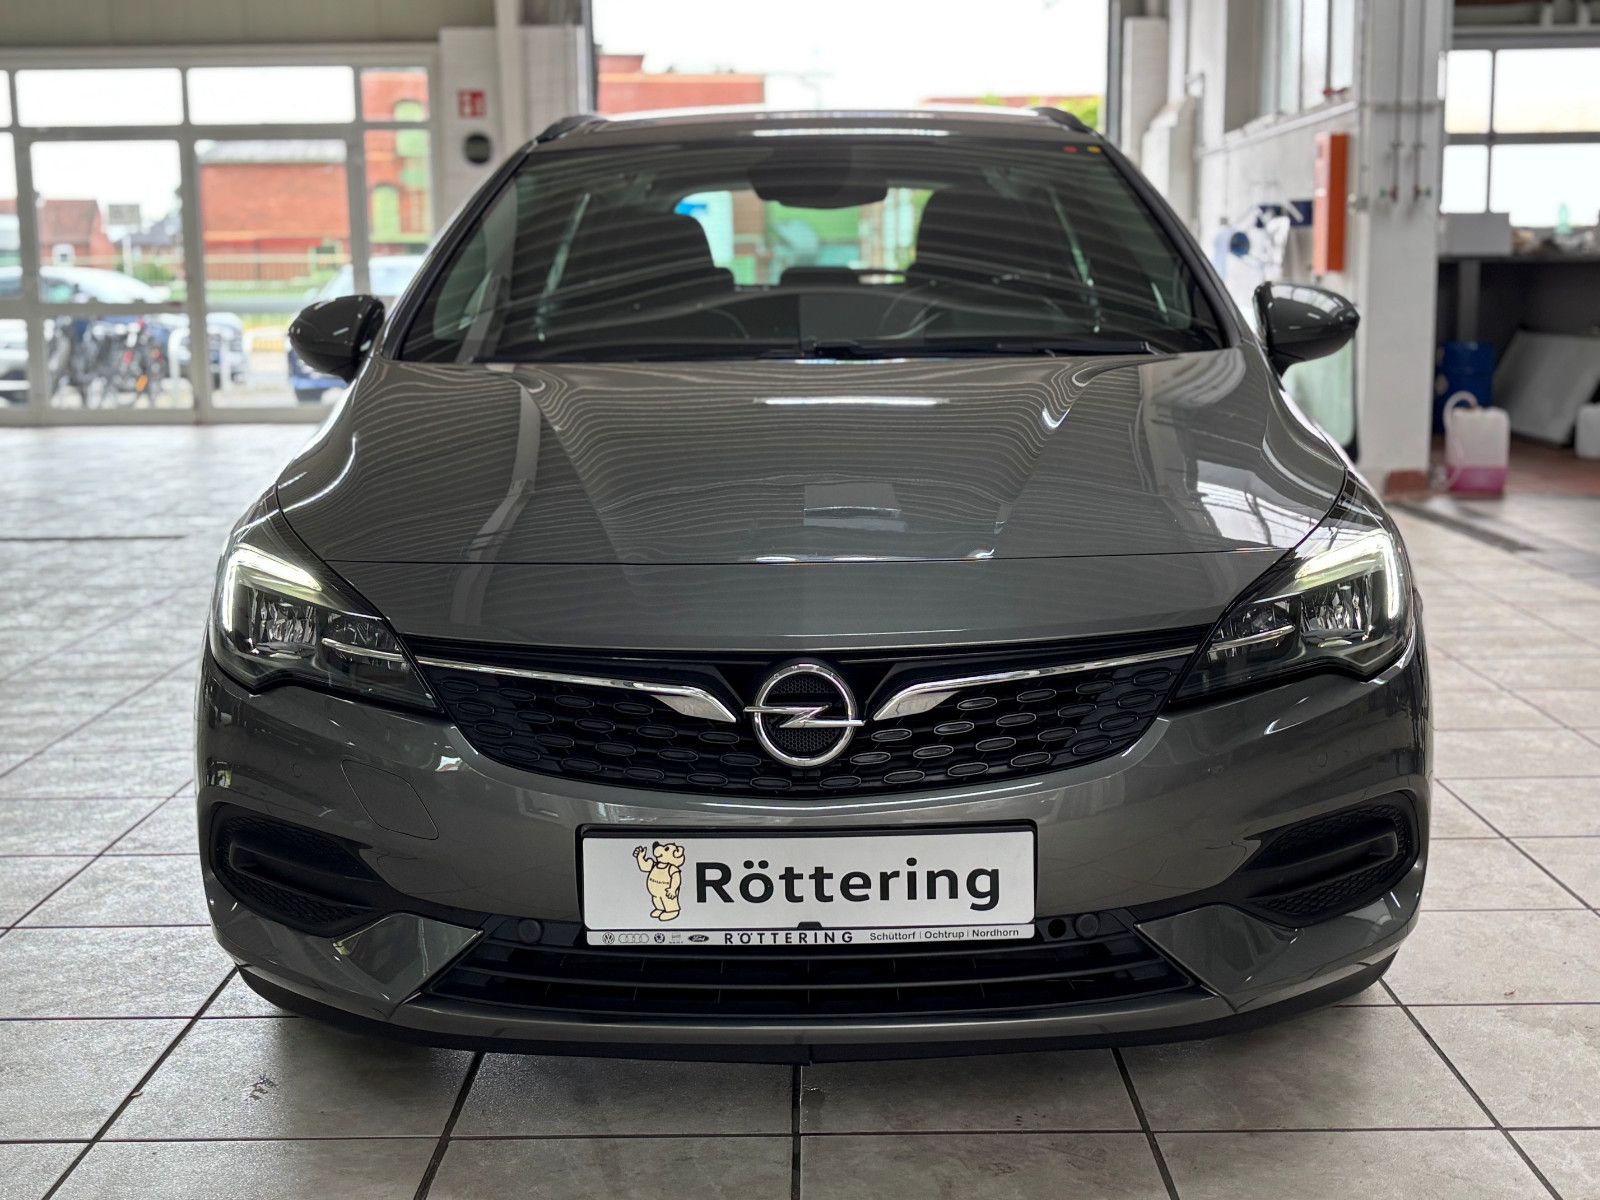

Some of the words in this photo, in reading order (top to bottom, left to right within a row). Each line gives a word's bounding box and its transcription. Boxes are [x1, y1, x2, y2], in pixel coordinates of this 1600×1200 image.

[695, 857, 1000, 911] Röttering
[724, 931, 853, 944] RÖTTERING
[925, 929, 965, 940] Ochtrup
[972, 928, 1019, 937] Nordhorn
